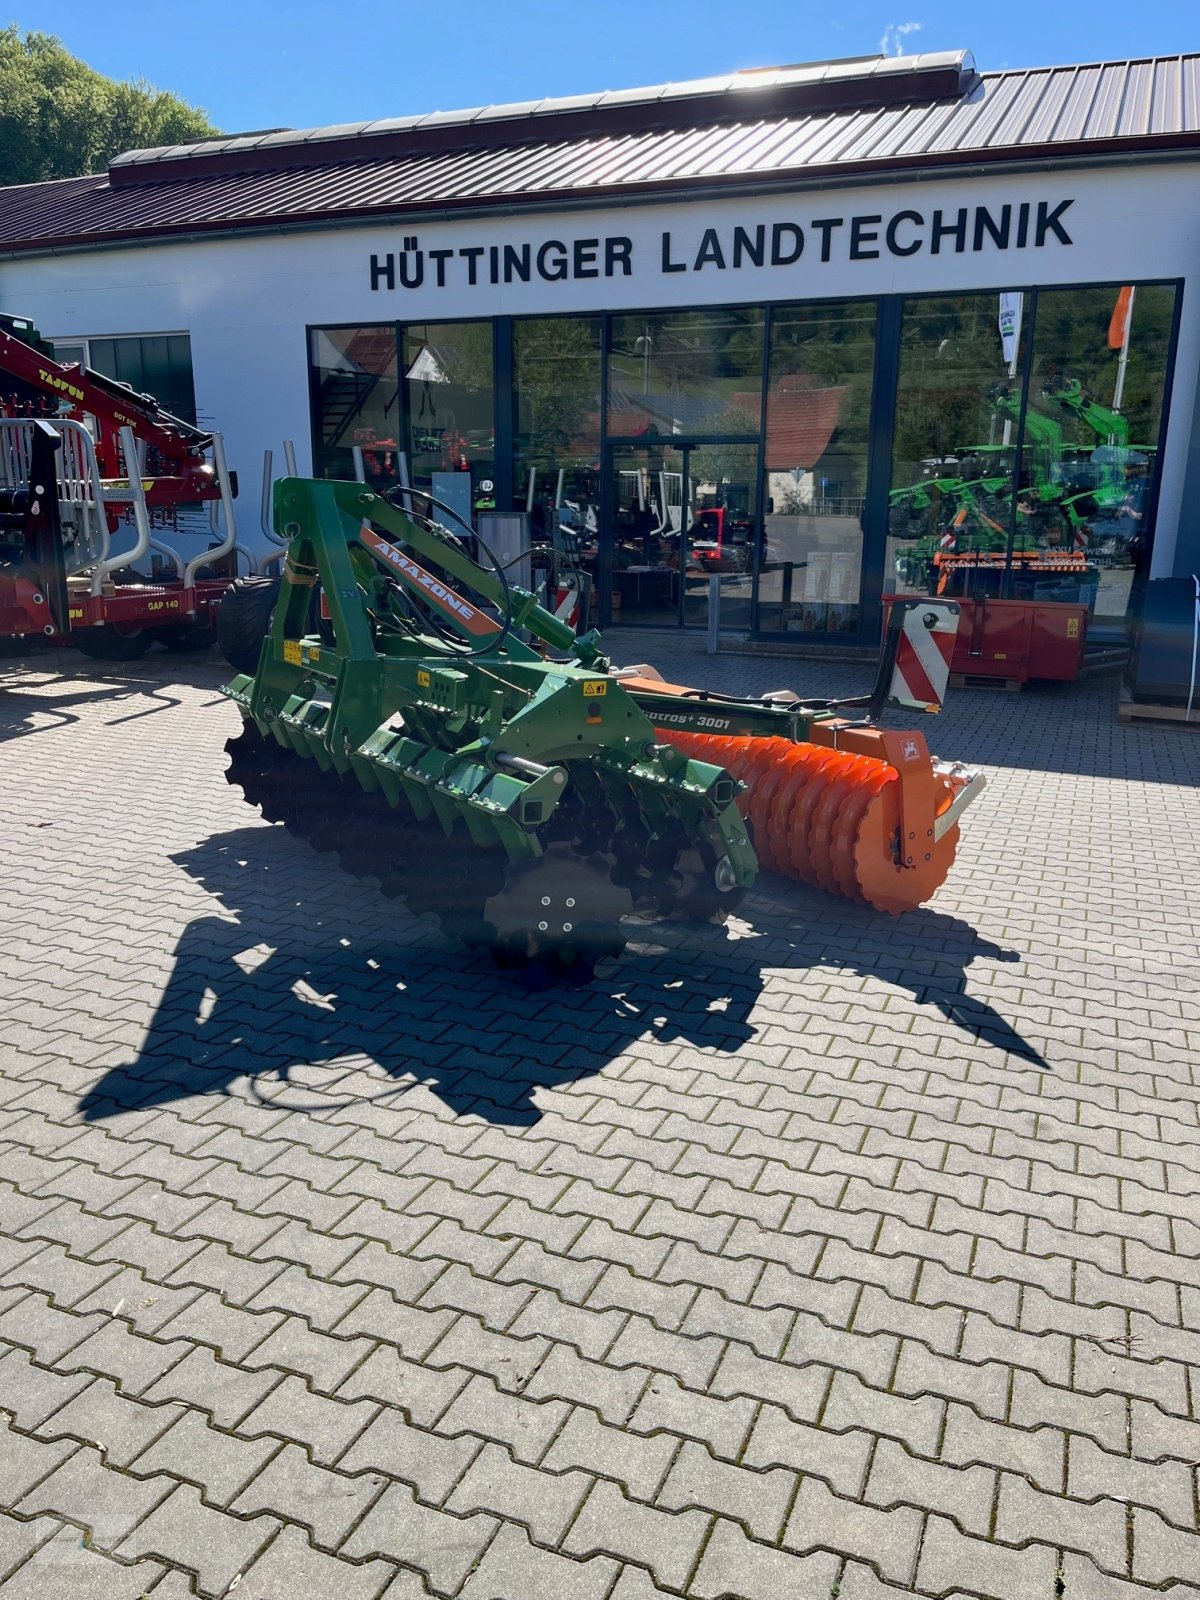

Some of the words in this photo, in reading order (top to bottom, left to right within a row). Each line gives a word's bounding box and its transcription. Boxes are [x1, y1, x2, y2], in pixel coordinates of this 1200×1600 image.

[370, 235, 633, 291] HÜTTINGER
[661, 199, 1075, 272] LANDTECHNIK
[39, 369, 84, 400] TAJFUN
[374, 543, 475, 620] AMAZONE
[148, 602, 164, 611] GAP
[166, 600, 179, 609] 140
[697, 716, 731, 730] 3001
